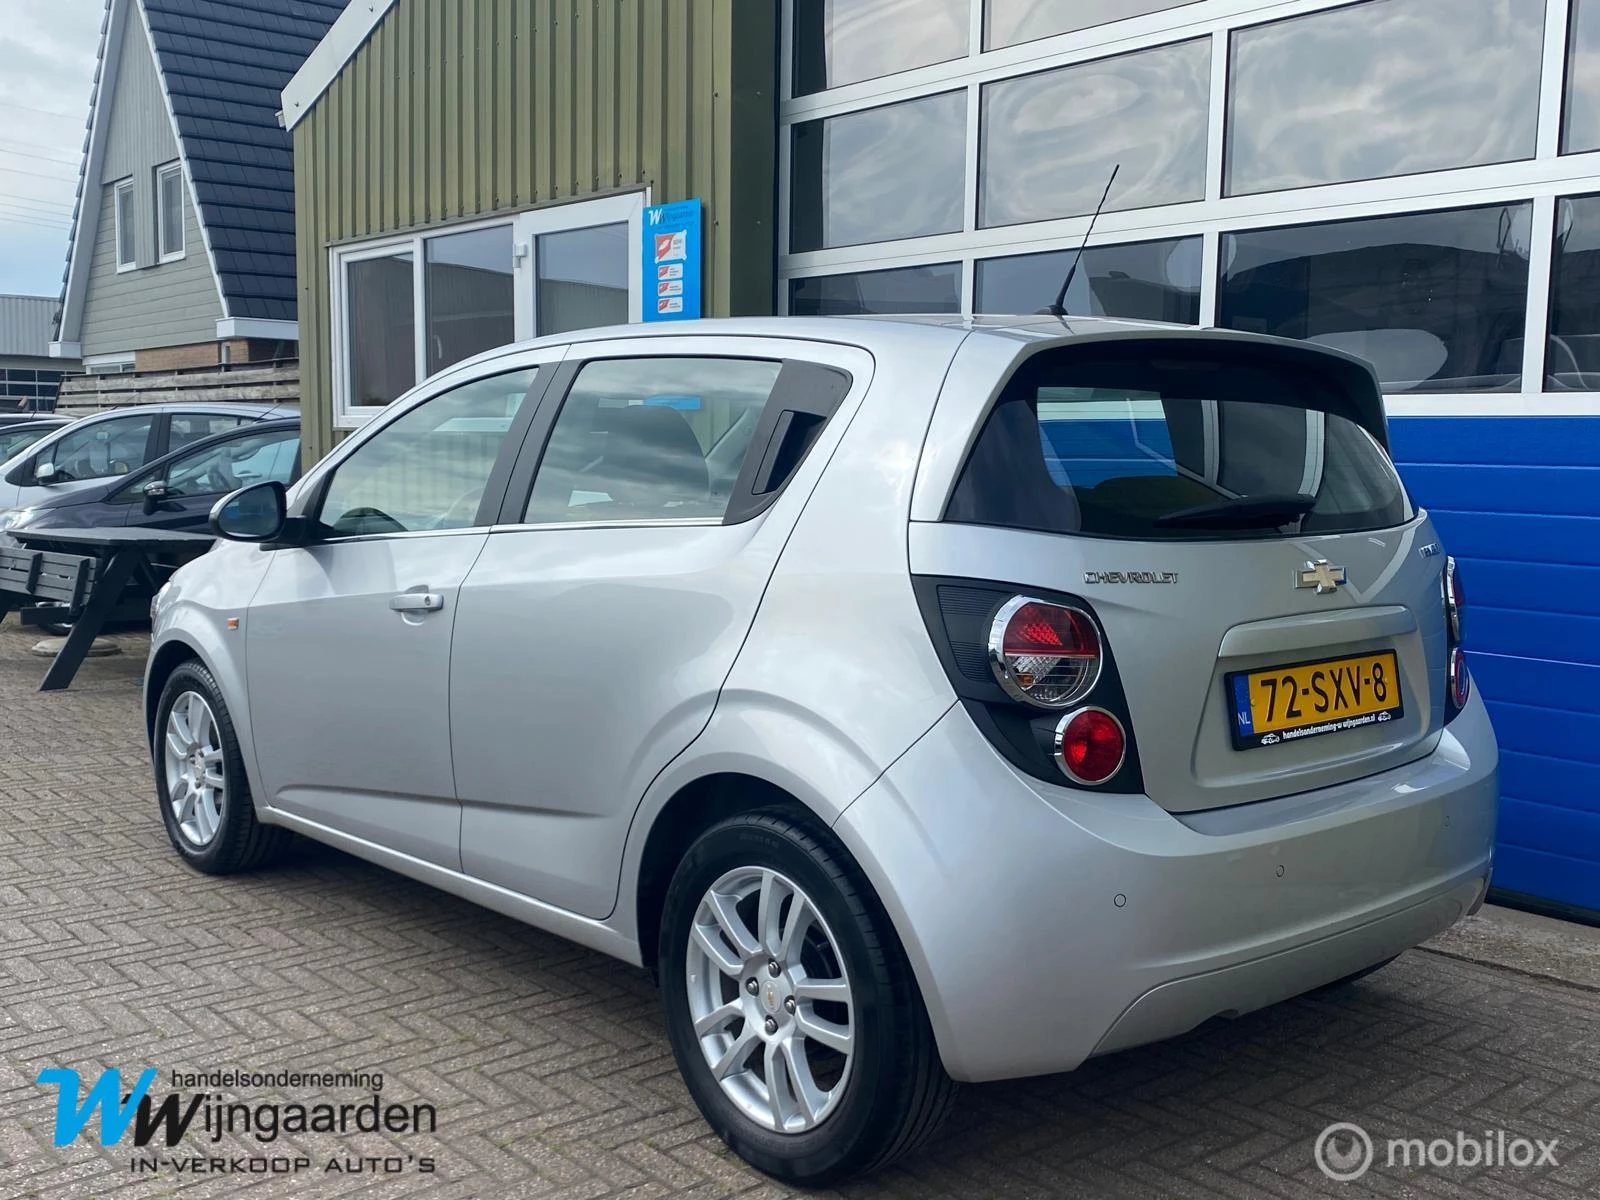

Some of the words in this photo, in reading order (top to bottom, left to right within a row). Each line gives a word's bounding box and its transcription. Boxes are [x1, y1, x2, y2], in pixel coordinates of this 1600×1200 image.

[1083, 571, 1179, 585] CHEVROLET
[1260, 662, 1387, 722] 72-SXV-8
[1237, 711, 1251, 726] NL
